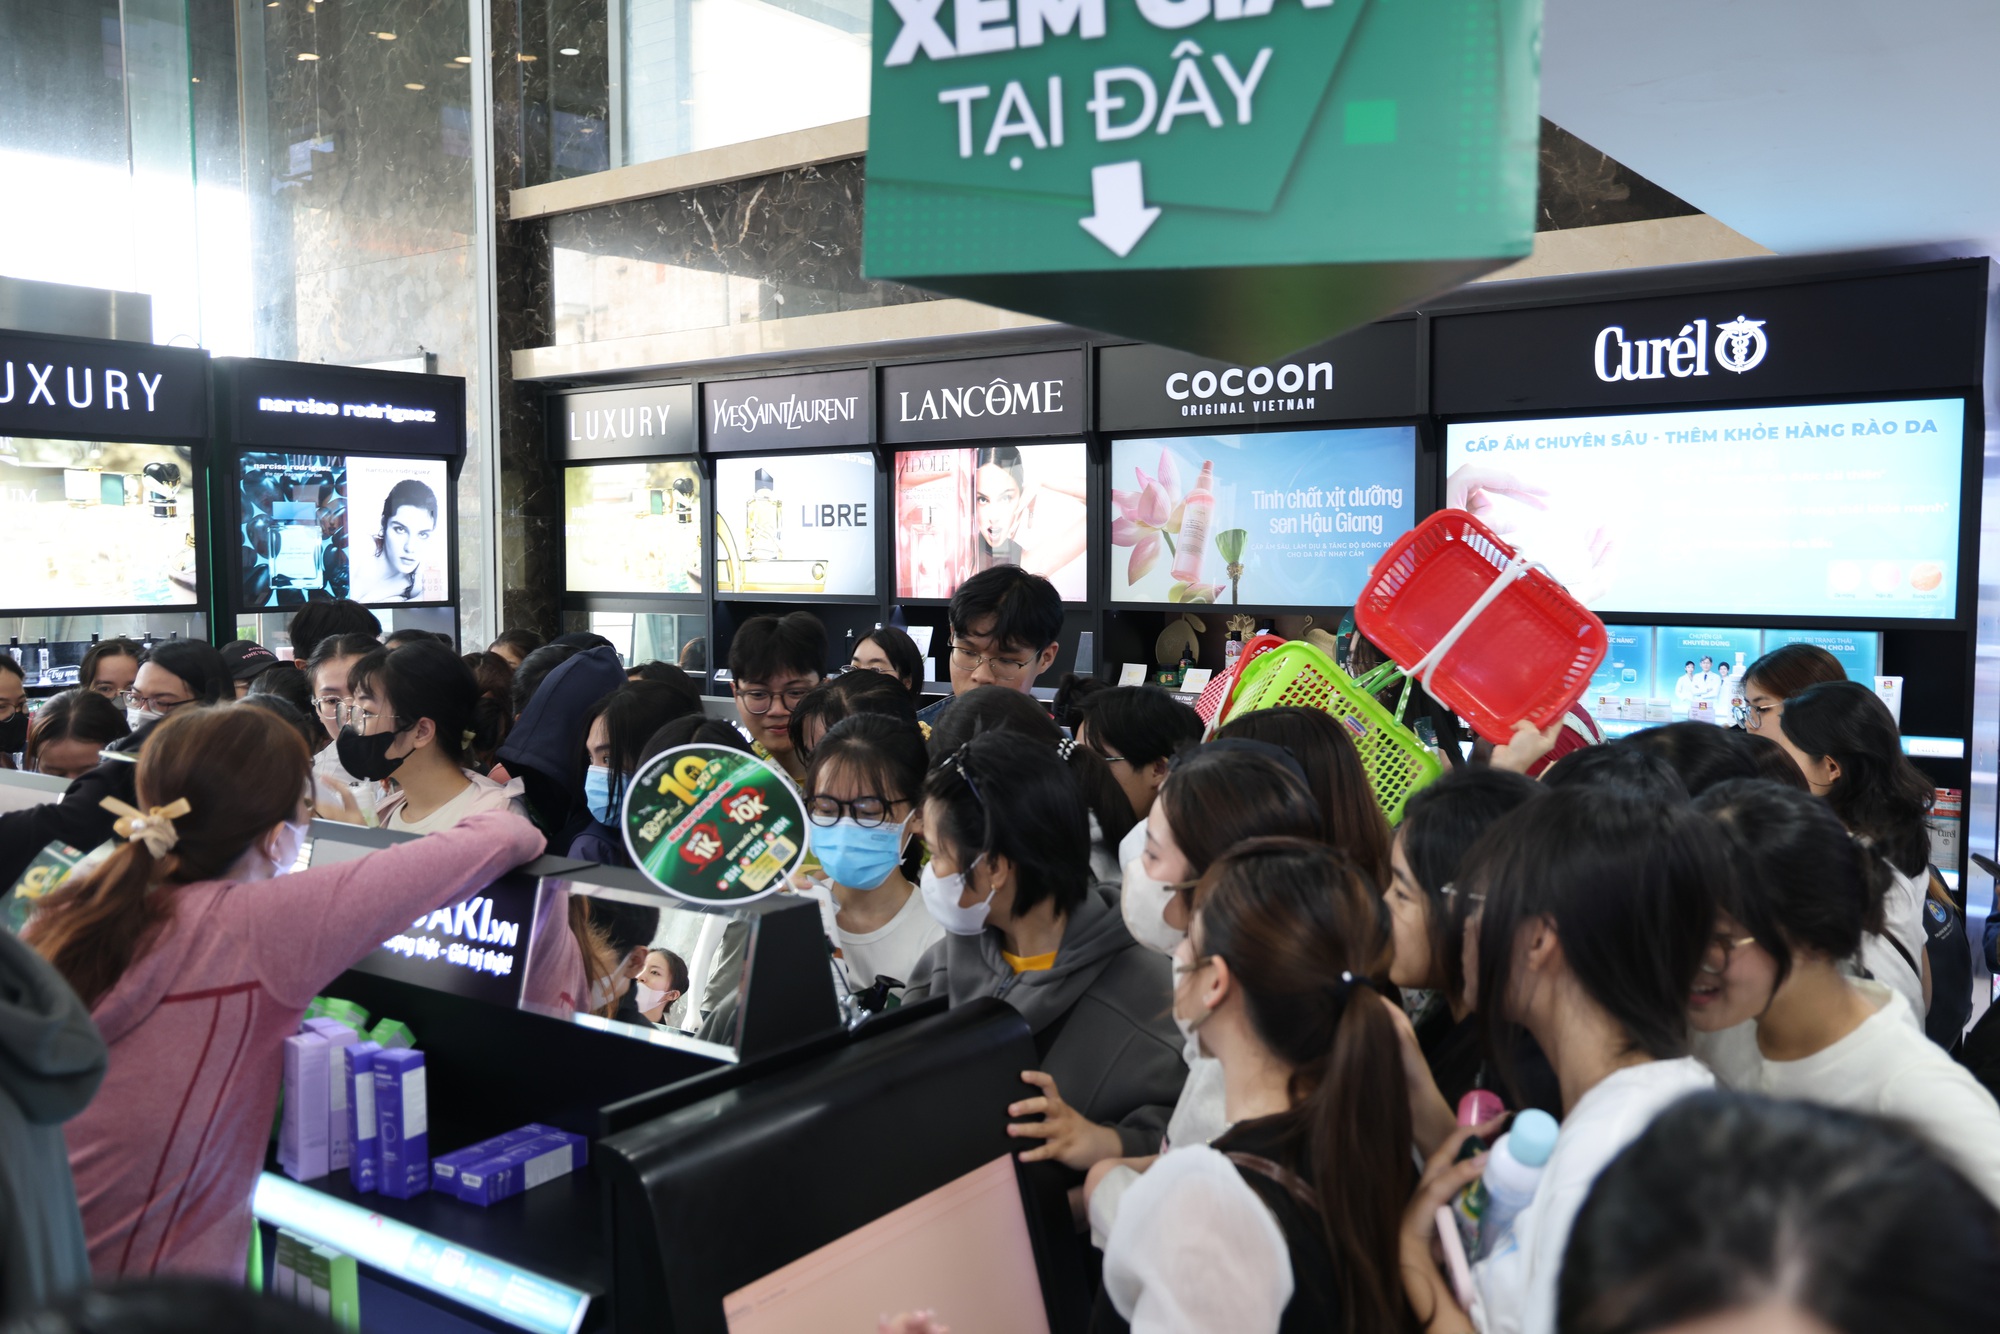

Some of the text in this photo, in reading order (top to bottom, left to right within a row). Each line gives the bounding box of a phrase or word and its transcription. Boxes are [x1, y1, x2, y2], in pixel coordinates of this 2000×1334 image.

[939, 41, 1273, 170] TẠI ĐÂY
[1594, 319, 1709, 383] Curél
[0, 361, 163, 412] UXURY
[1165, 362, 1333, 401] cocoon
[258, 396, 437, 424] narciso rodriguez
[899, 377, 1063, 422] LANCÔME
[1181, 397, 1315, 417] ORIGINAL VIETNAM
[570, 404, 671, 441] LUXURY
[1465, 434, 1499, 453] CẤP
[1535, 431, 1606, 450] CHUYÊN
[1611, 429, 1648, 447] SÂU
[1665, 426, 1718, 444] THÊM
[1724, 420, 1779, 442] KHỎE
[1785, 420, 1845, 439] HÀNG
[1851, 417, 1899, 437] RÀO
[1904, 419, 1939, 435] DA
[253, 462, 332, 473] narciso rodriguez
[1286, 486, 1322, 509] chất
[1325, 487, 1346, 514] xịt
[1348, 485, 1403, 510] dưỡng
[802, 503, 867, 527] LIBRE
[1269, 512, 1384, 538] sen Hậu Giang
[50, 669, 64, 679] Try
[657, 755, 718, 807] 10
[729, 795, 770, 825] 10K
[694, 834, 721, 860] 1K
[747, 840, 766, 859] 12H
